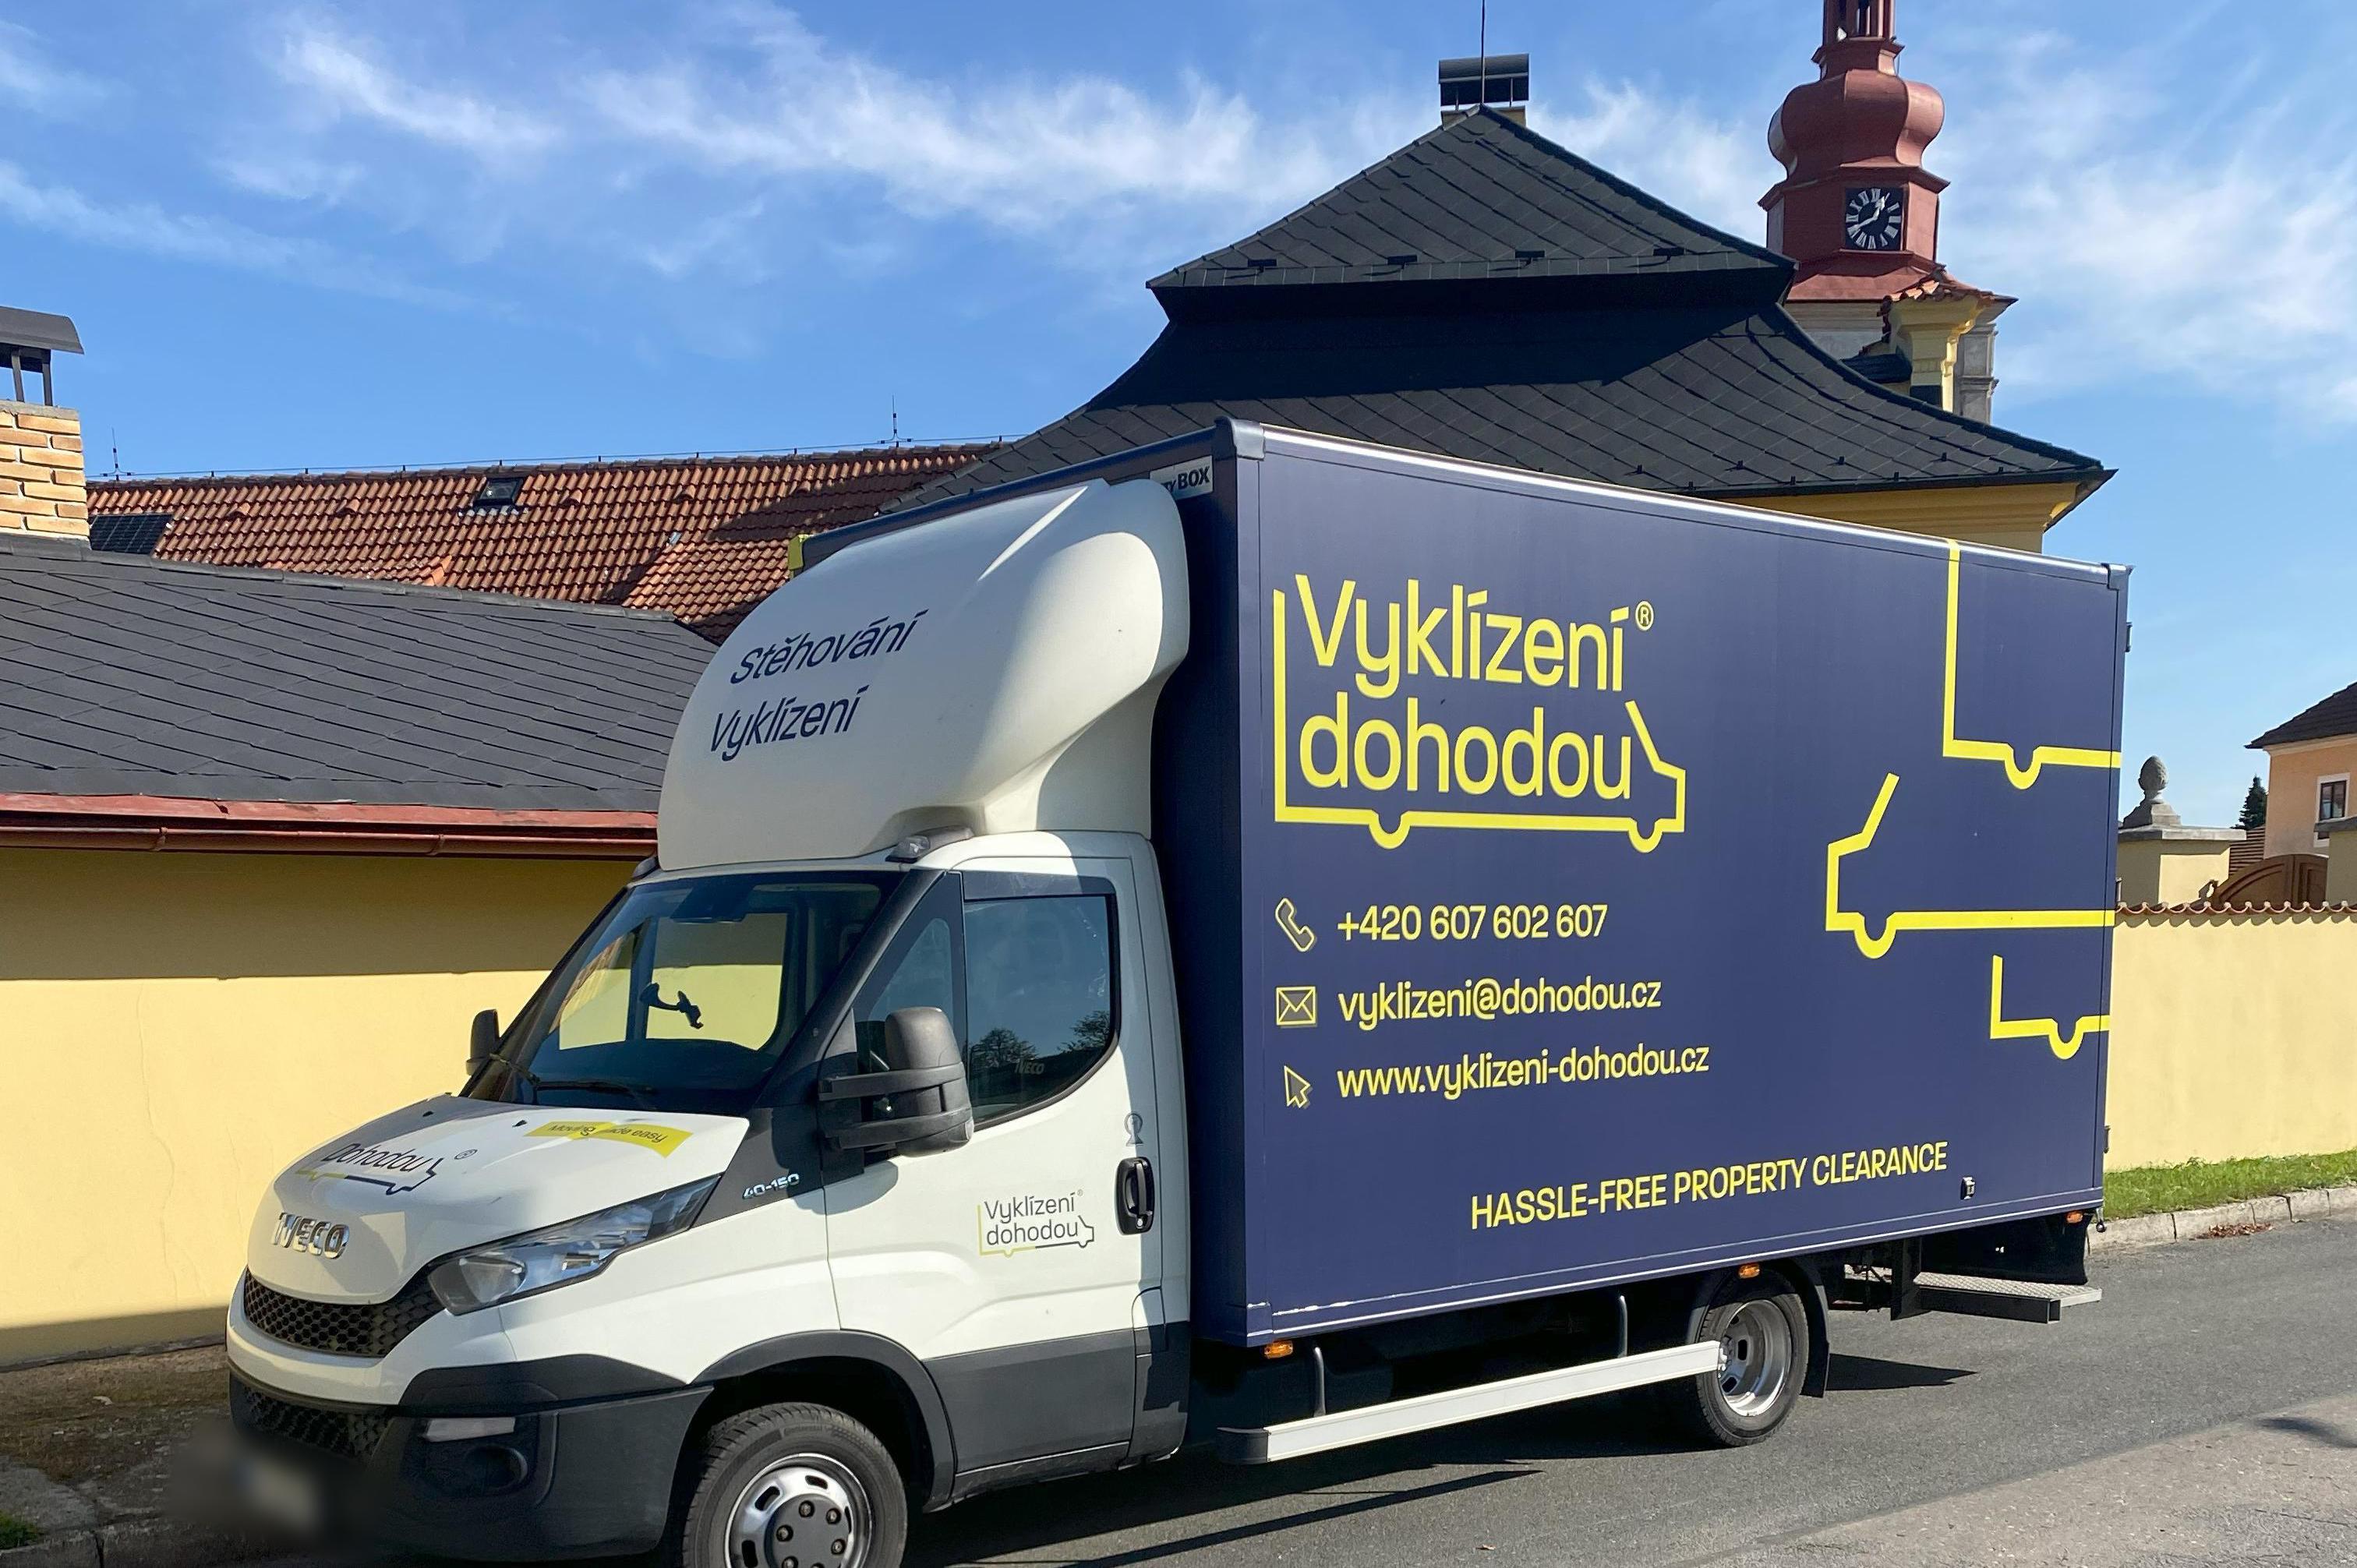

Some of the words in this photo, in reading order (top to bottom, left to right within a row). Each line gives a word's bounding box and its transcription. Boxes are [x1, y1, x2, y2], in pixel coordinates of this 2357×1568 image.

[730, 609, 928, 683] Stěhování
[711, 685, 869, 761] Vyklízení
[1300, 691, 1631, 800] dohodou
[1338, 906, 1421, 940] +420
[1430, 906, 1486, 939] 607
[1493, 905, 1549, 938] 602
[1557, 905, 1607, 938] 607
[1338, 976, 1659, 1030] vyklizeni@dohodou.cz
[1338, 1044, 1709, 1100] www.vyklizeni-dohodou.cz
[632, 1130, 667, 1143] easy
[1472, 1174, 1666, 1227] HASSLE-FREE
[1674, 1159, 1806, 1201] PROPERTY
[1813, 1142, 1945, 1185] CLEARANCE
[274, 1213, 349, 1259] IVECO
[987, 1219, 1078, 1245] dohodou
